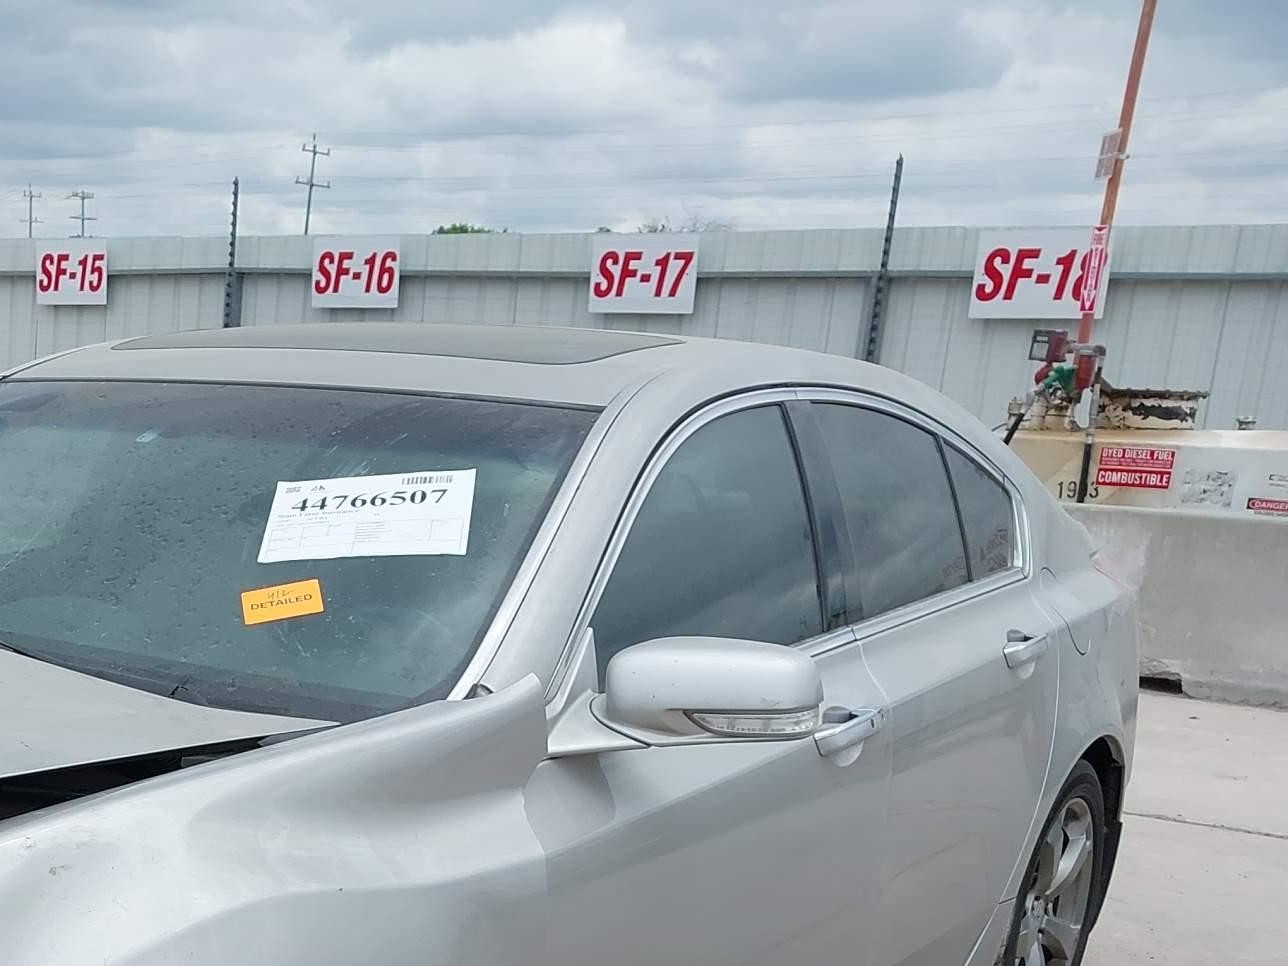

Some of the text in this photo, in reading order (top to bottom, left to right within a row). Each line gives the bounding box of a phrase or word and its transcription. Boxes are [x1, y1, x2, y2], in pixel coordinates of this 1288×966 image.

[39, 253, 105, 293] SF-15
[314, 251, 397, 295] SF-16
[593, 251, 694, 299] SF-17
[1102, 448, 1173, 461] DYED DIESEL FUEL
[1098, 470, 1170, 486] COMBUSTIBLE
[290, 488, 448, 512] 44766507
[1057, 480, 1099, 499] 193
[250, 593, 313, 611] DETAILED
